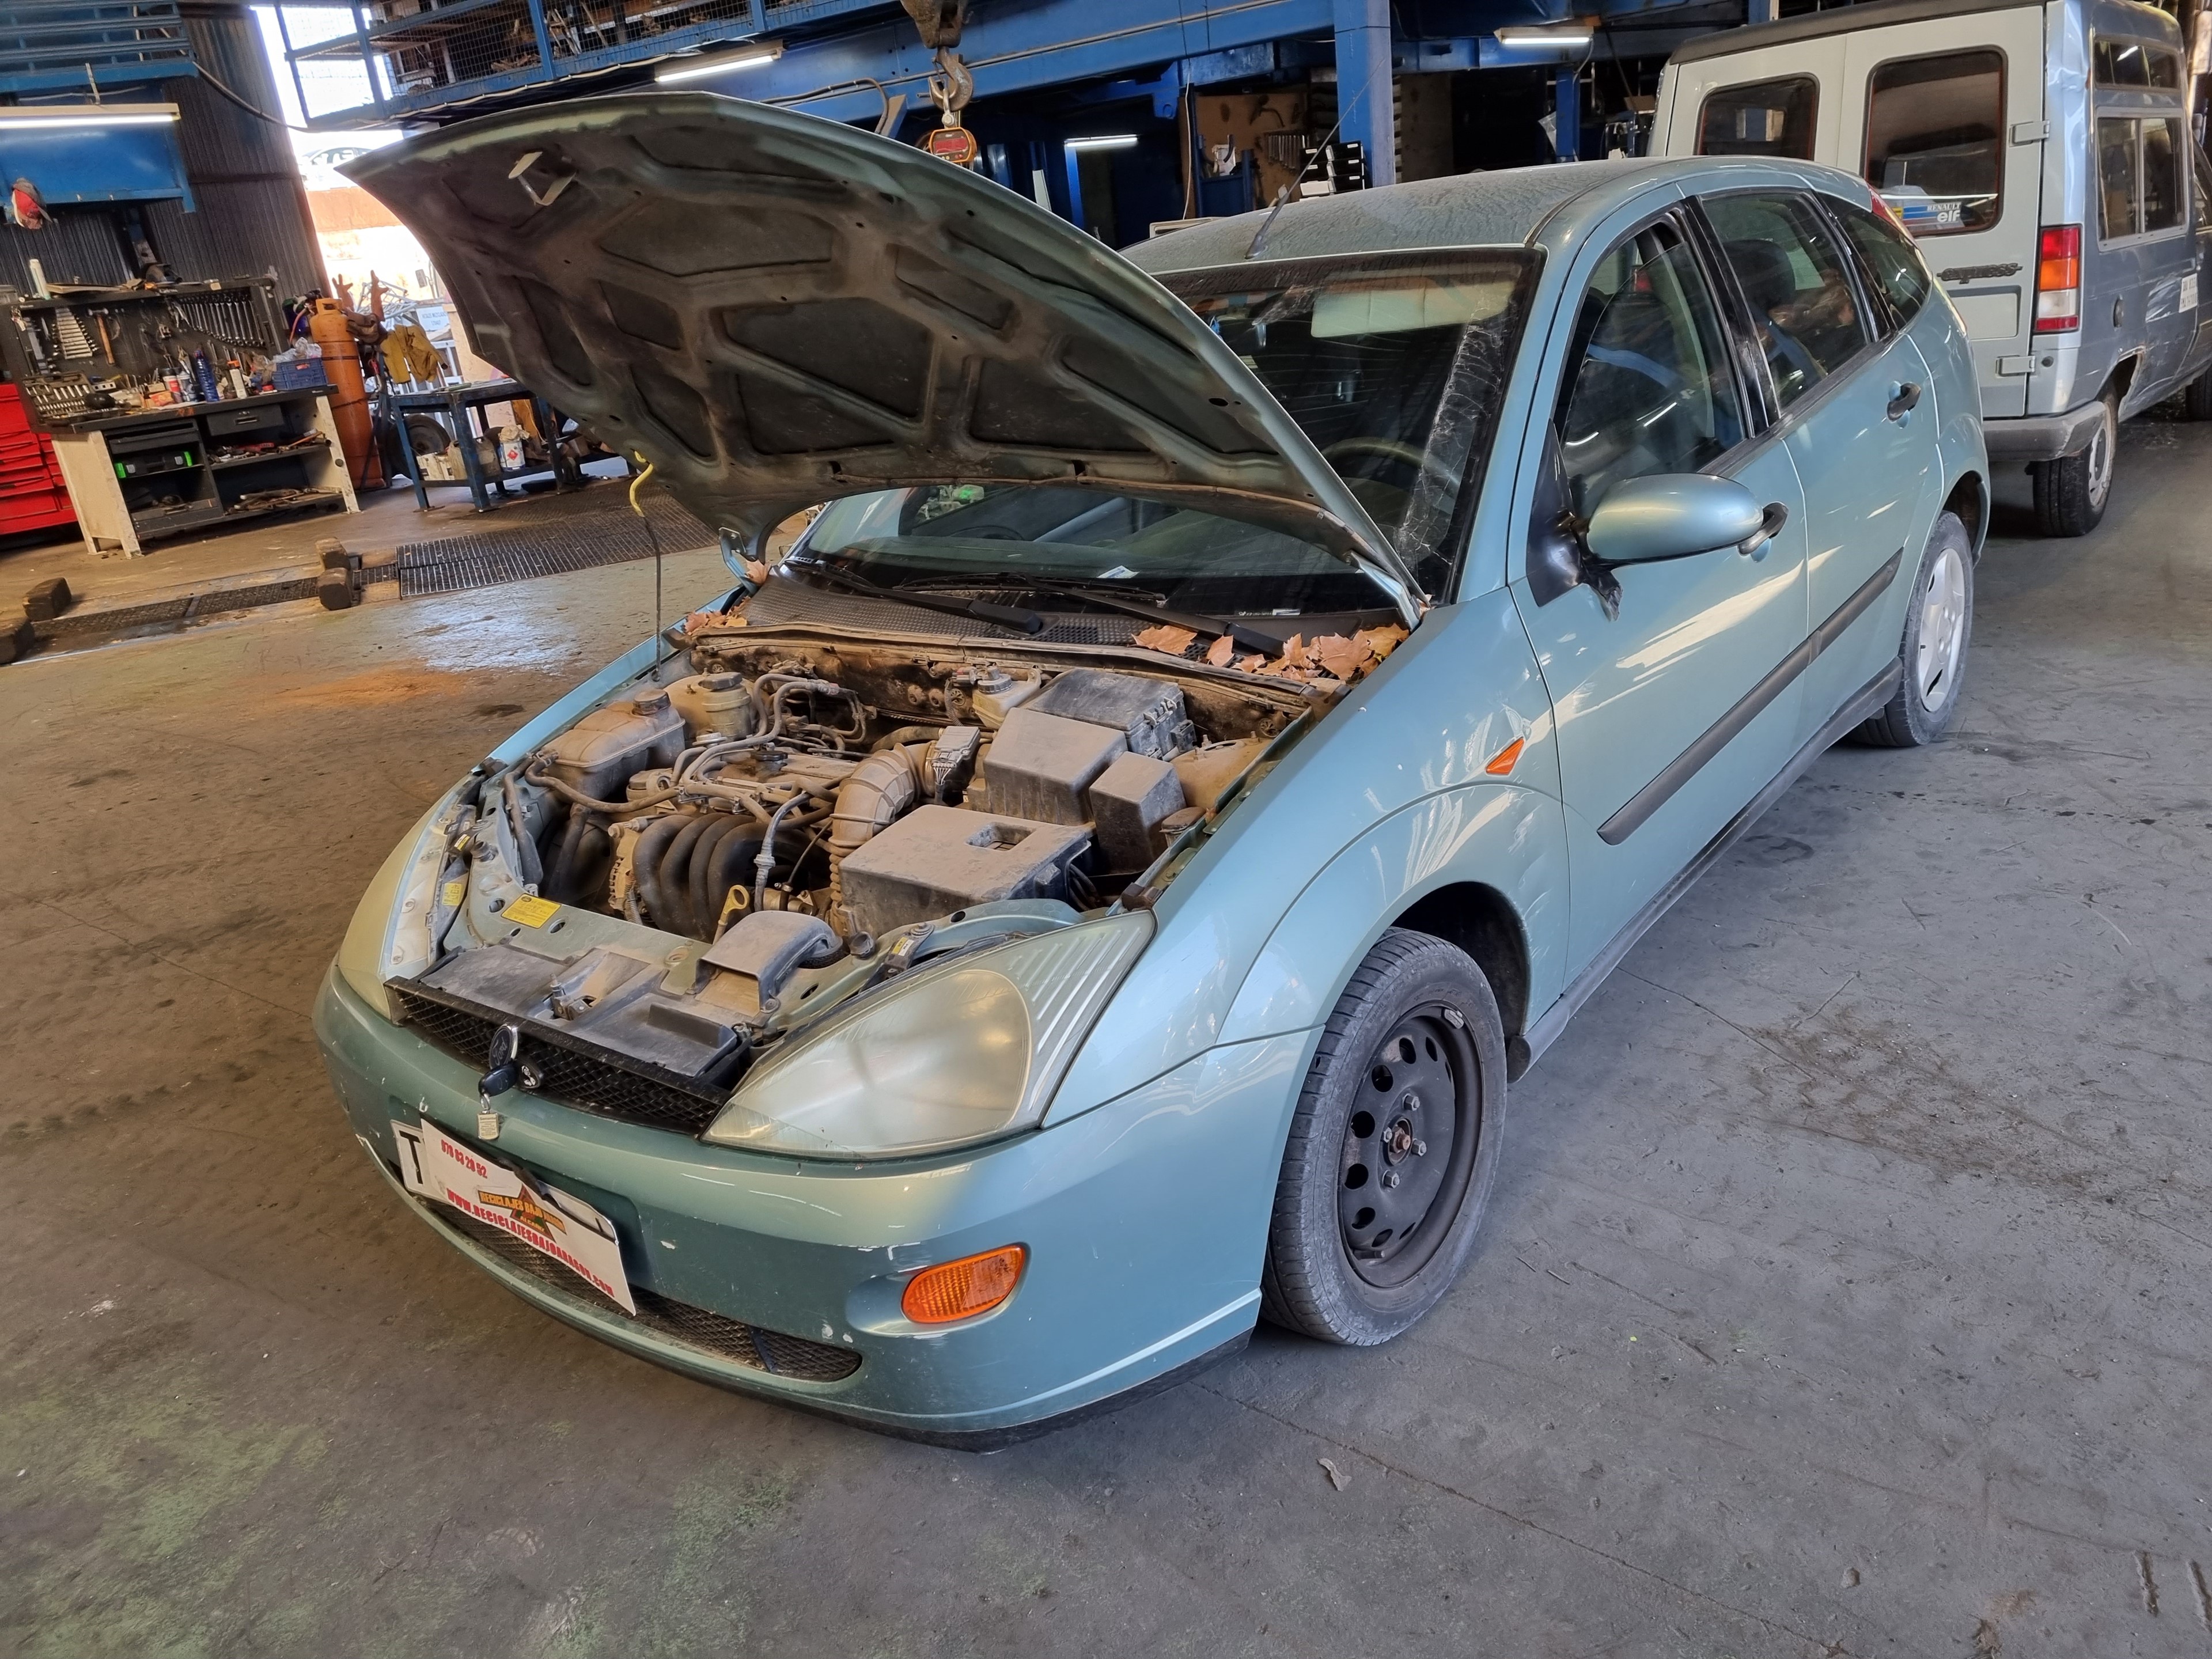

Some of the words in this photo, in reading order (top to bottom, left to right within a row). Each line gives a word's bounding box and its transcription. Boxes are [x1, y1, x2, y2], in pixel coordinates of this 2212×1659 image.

[1927, 202, 1961, 211] RENAULT
[1937, 210, 1960, 222] elf
[493, 1036, 507, 1065] Ford
[479, 1192, 524, 1211] RECICLAJES
[524, 1202, 543, 1217] BAJO
